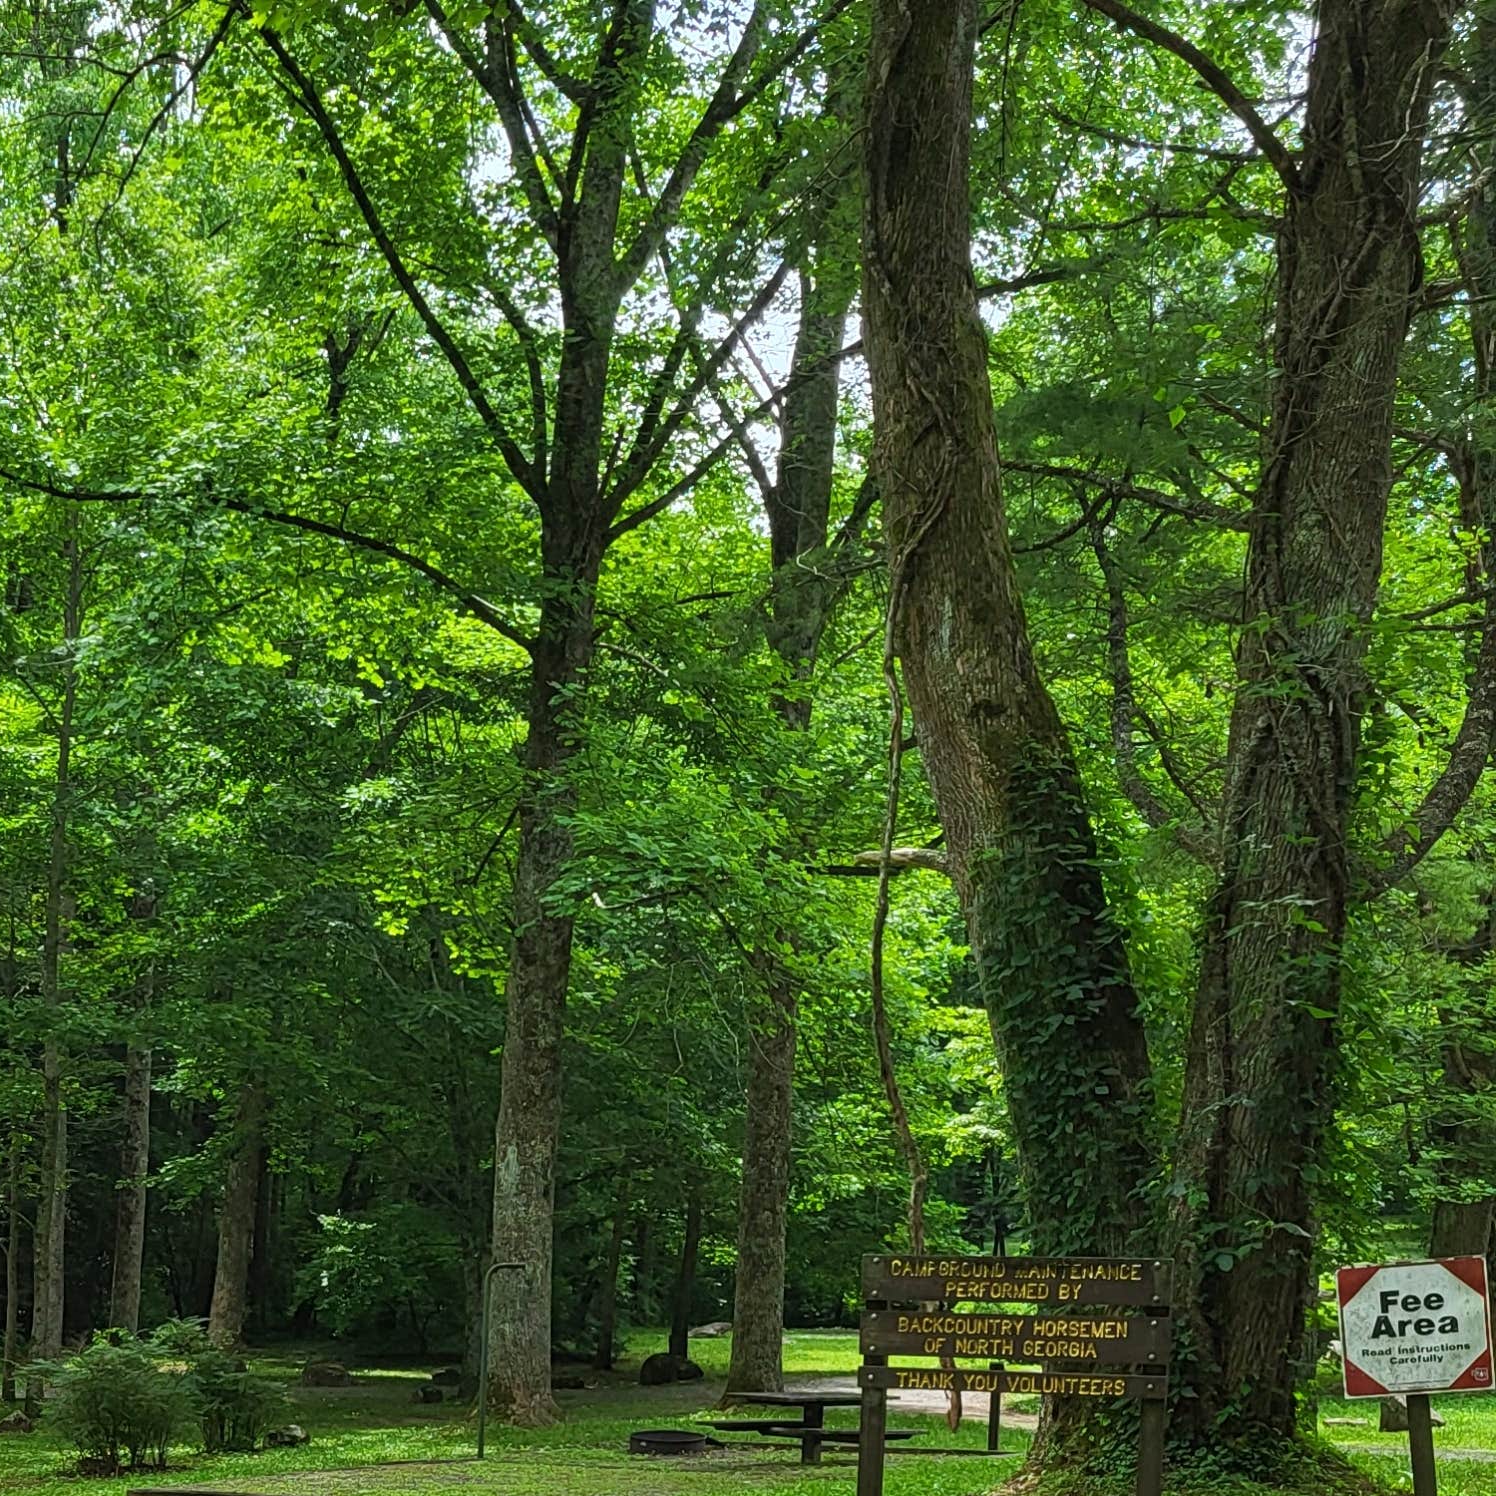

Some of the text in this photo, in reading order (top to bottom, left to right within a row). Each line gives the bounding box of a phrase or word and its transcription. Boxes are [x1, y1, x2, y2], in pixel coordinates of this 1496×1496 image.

[945, 1282, 1081, 1300] PERFORMED BY
[1380, 1290, 1444, 1313] Fee
[898, 1316, 1128, 1338] BACKCOUNTRY HORSEMEN
[1371, 1316, 1459, 1339] Area
[924, 1338, 1096, 1358] OF NORTH GEORGIA
[1362, 1343, 1470, 1357] Read Instructions
[1390, 1355, 1443, 1365] Carefully
[897, 1372, 1125, 1396] THANK YOU VOLUNTEERS
